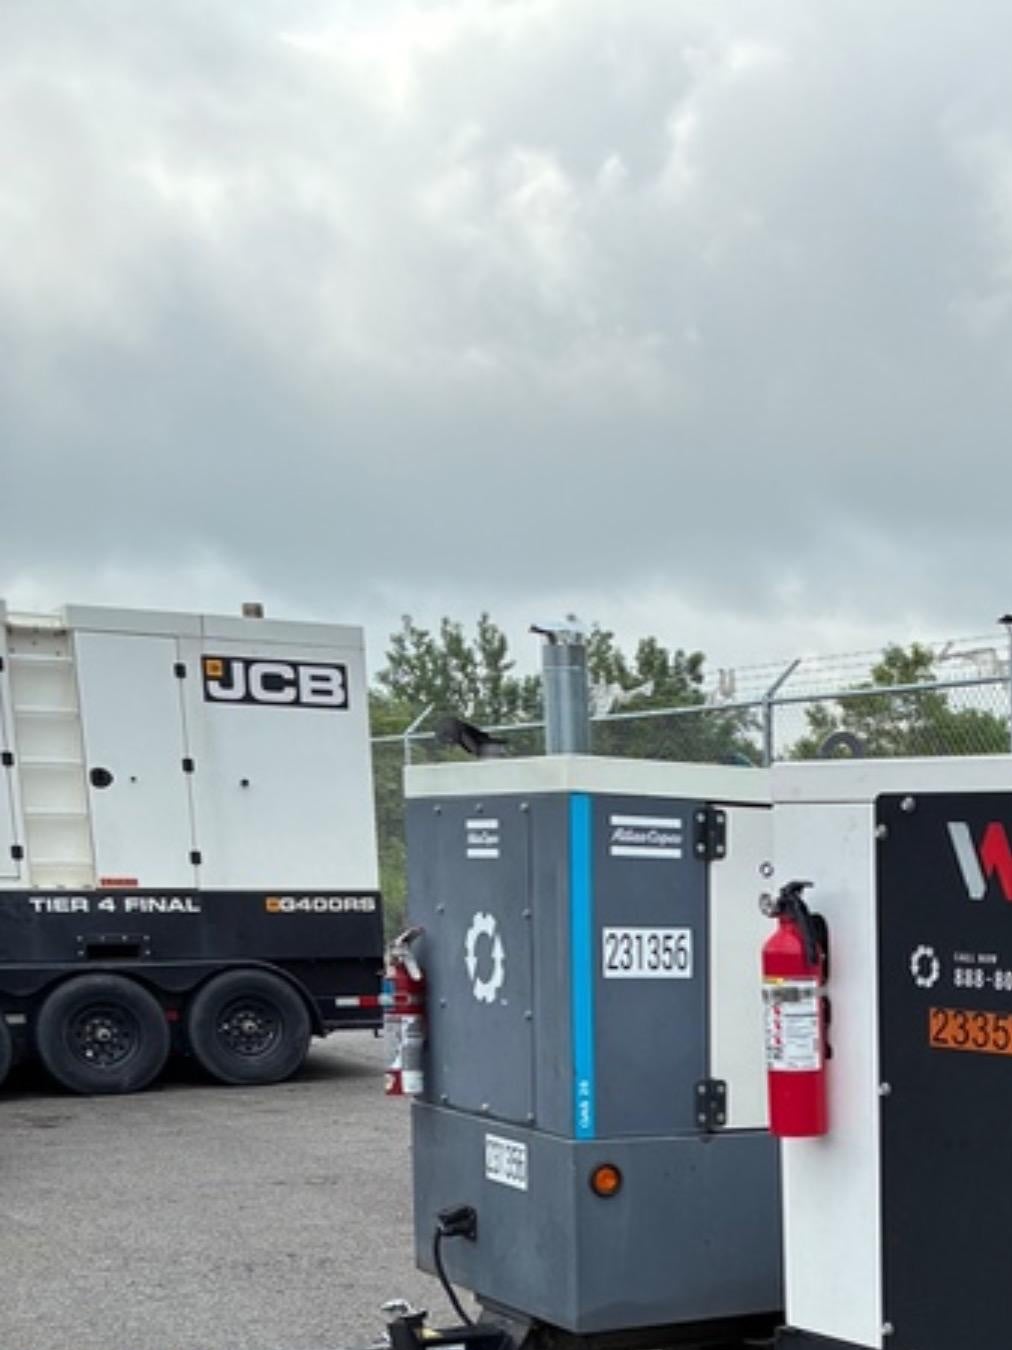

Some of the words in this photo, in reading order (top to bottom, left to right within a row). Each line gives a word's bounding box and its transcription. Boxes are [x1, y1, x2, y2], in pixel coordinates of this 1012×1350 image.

[207, 661, 346, 706] JCB
[29, 897, 90, 913] TIER
[98, 897, 116, 913] 4
[124, 897, 200, 913] FINAL
[605, 932, 687, 971] 231356
